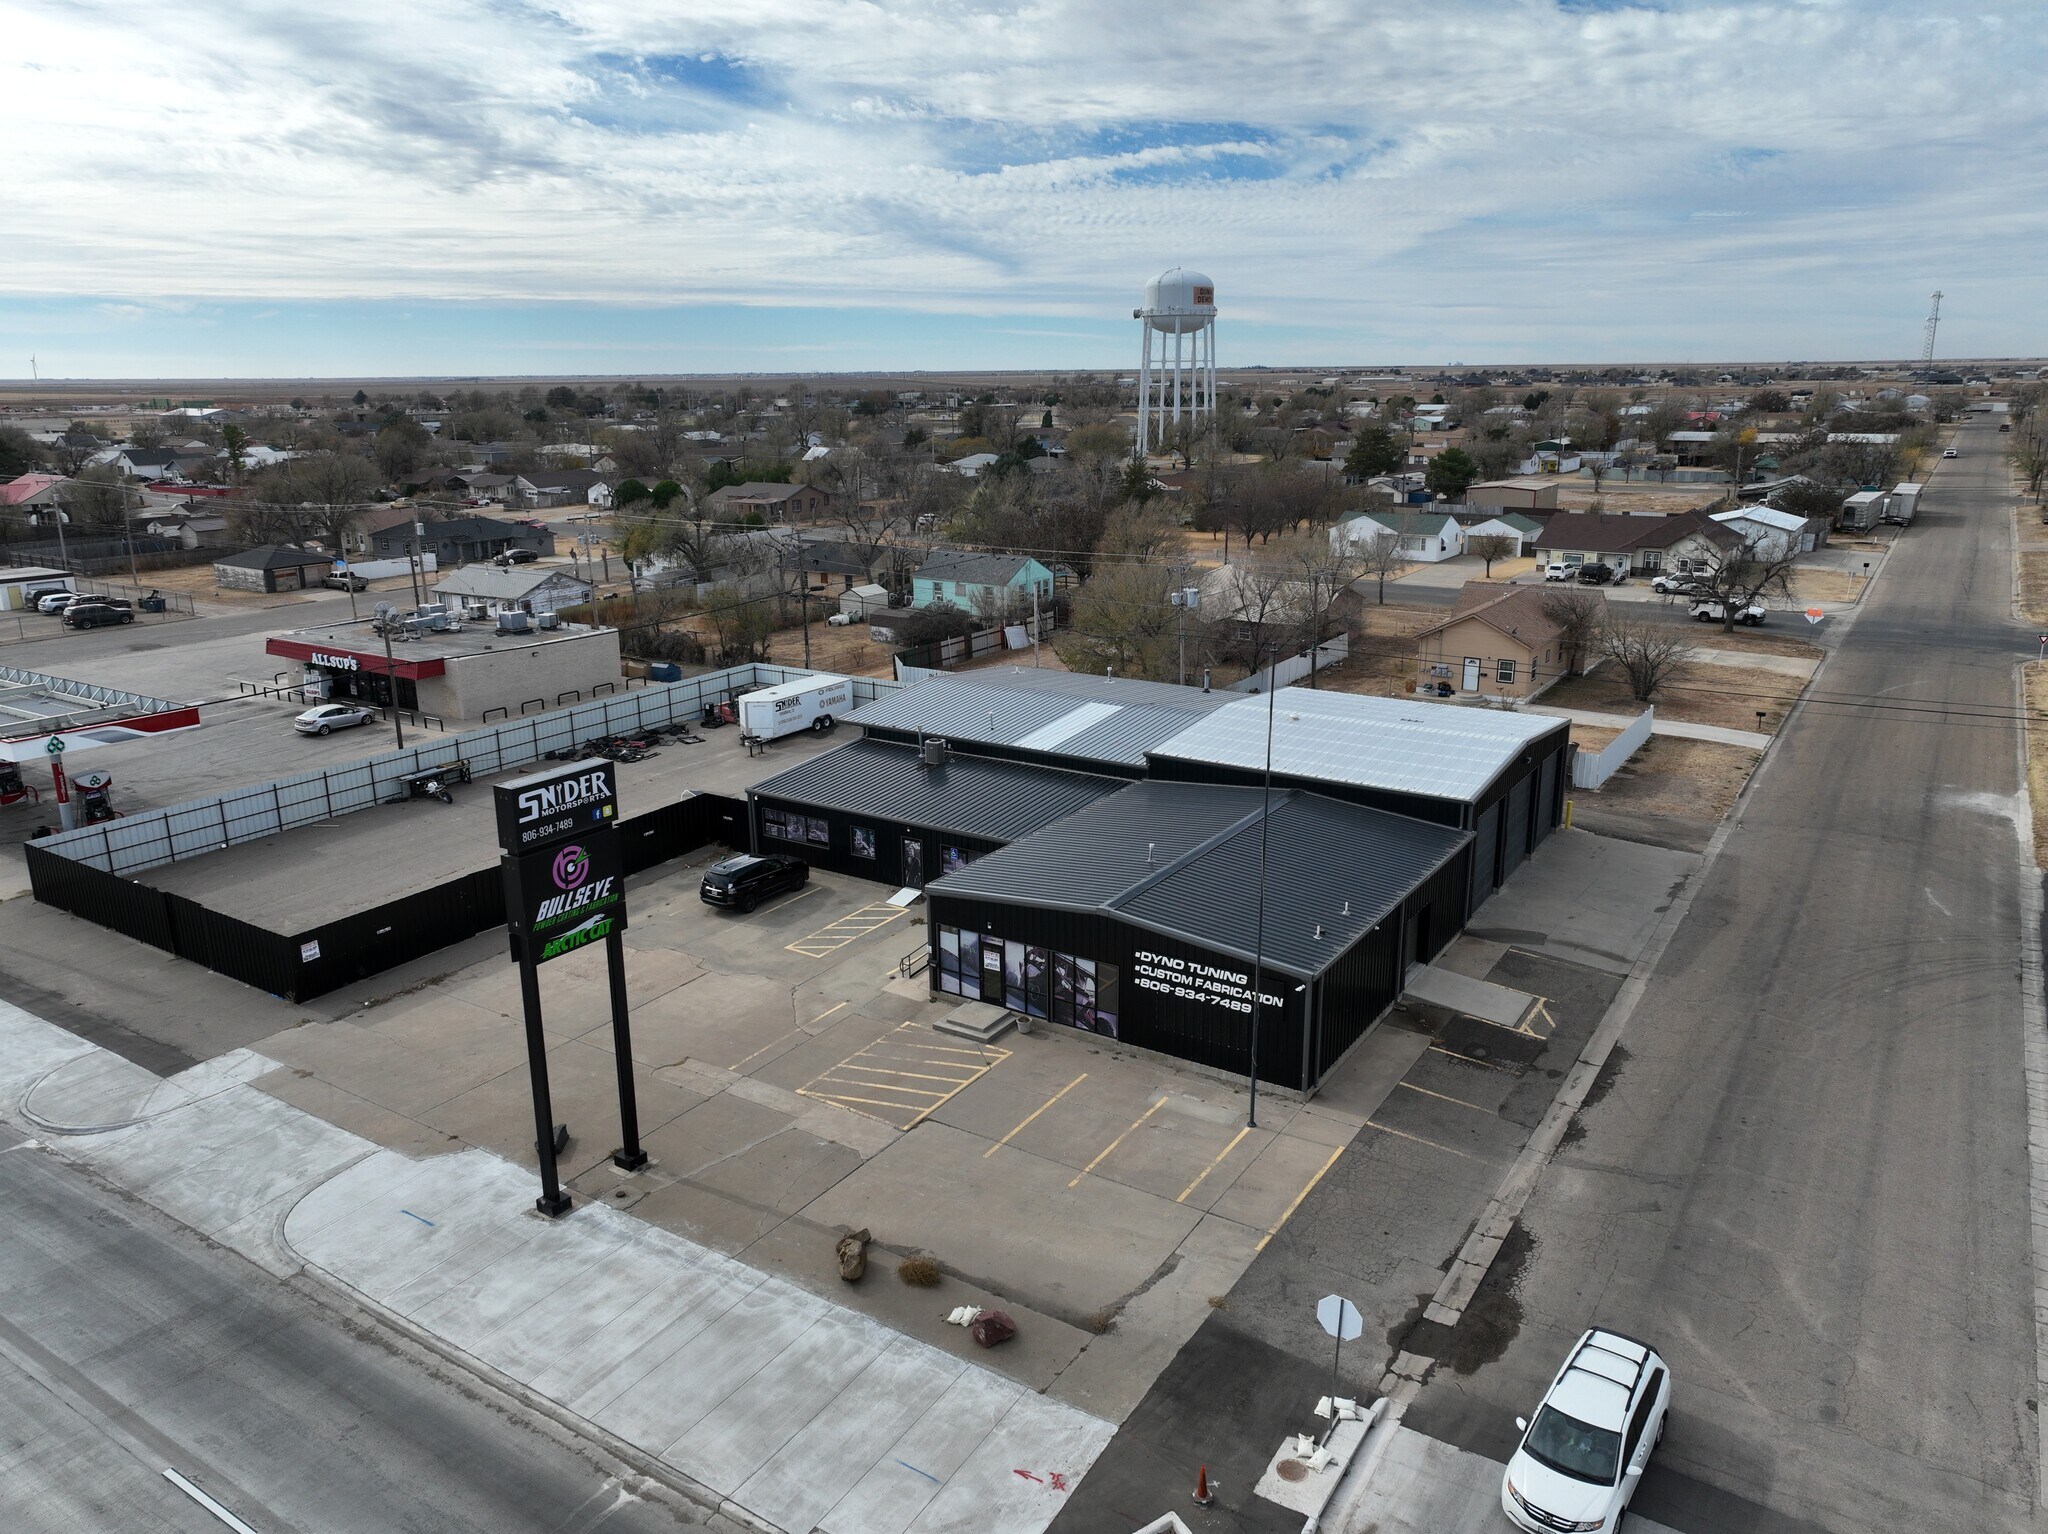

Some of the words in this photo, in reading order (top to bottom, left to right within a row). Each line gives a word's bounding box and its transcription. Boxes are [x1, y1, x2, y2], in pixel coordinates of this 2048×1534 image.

[311, 652, 358, 671] ALLSUP'S
[826, 694, 846, 706] YAMAHA
[518, 771, 612, 824] SNIDER
[541, 793, 606, 817] MOTORSPORTS
[522, 818, 574, 843] 806-934-7489
[536, 876, 614, 923] BULLSEYE
[532, 917, 556, 932] POWDER
[540, 928, 587, 960] ARCTIC
[589, 918, 615, 940] CAT
[1140, 951, 1185, 970] DYNO
[1188, 962, 1248, 985] TUNING
[1139, 979, 1252, 1014] 806-934-7489
[1140, 965, 1193, 986] CUSTOM
[1195, 978, 1284, 1008] FABRICATION
